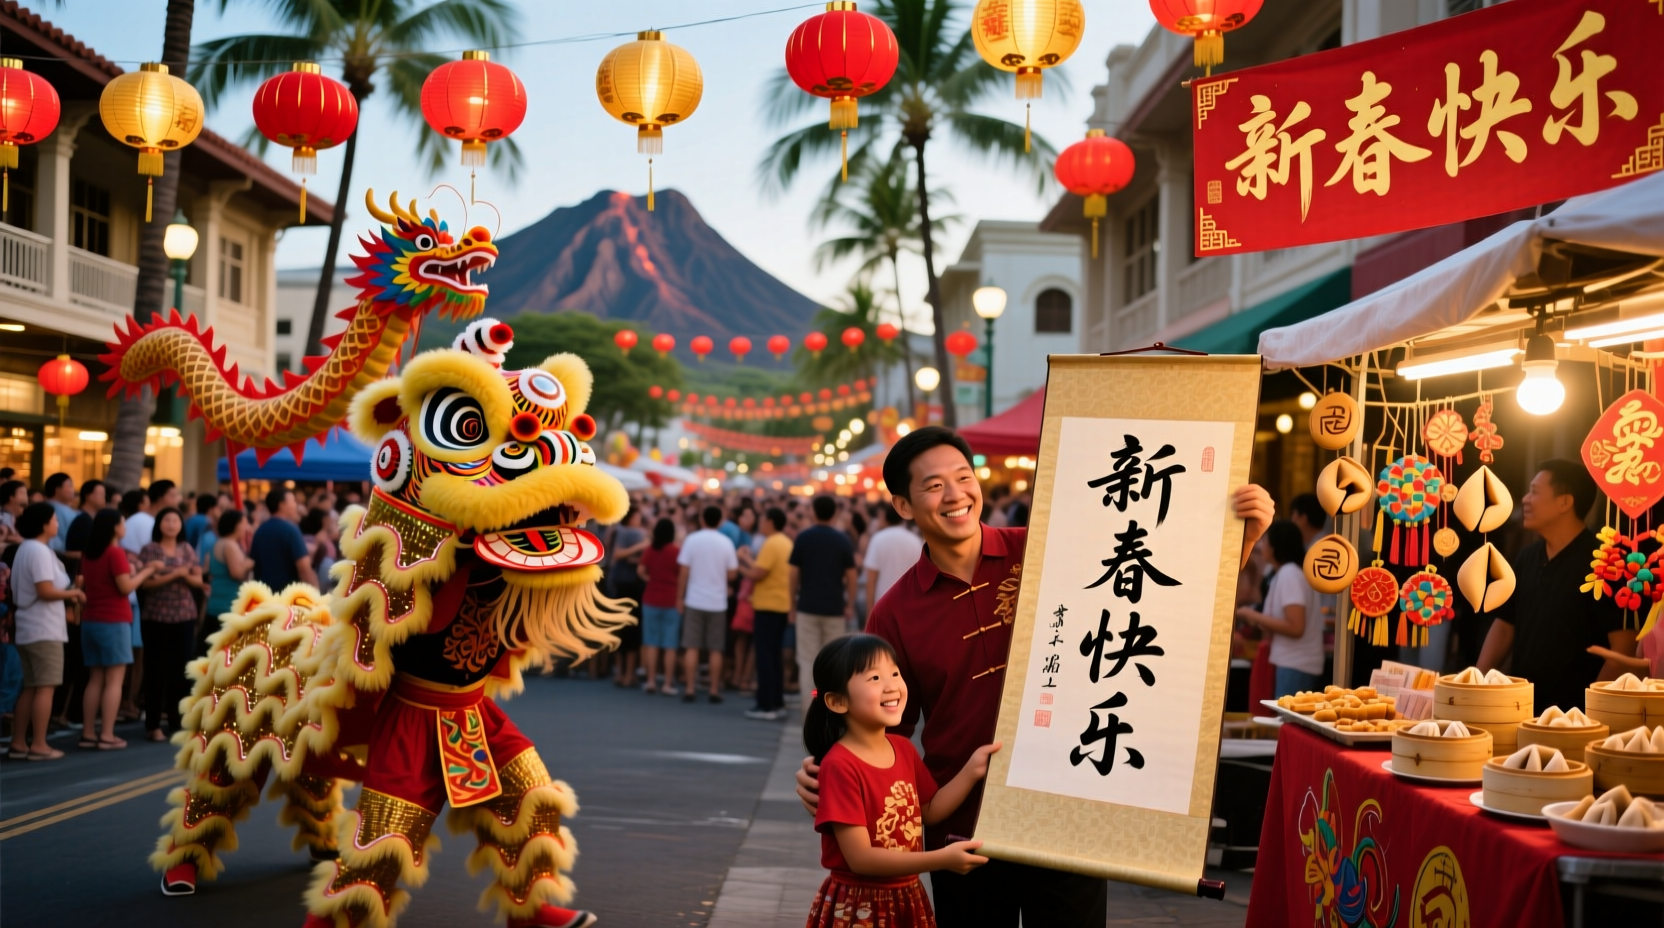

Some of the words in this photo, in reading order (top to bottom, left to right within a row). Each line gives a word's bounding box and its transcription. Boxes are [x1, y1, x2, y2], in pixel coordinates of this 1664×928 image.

[1225, 11, 1639, 224] 新春快乐
[1070, 434, 1186, 776] 新春快乐
